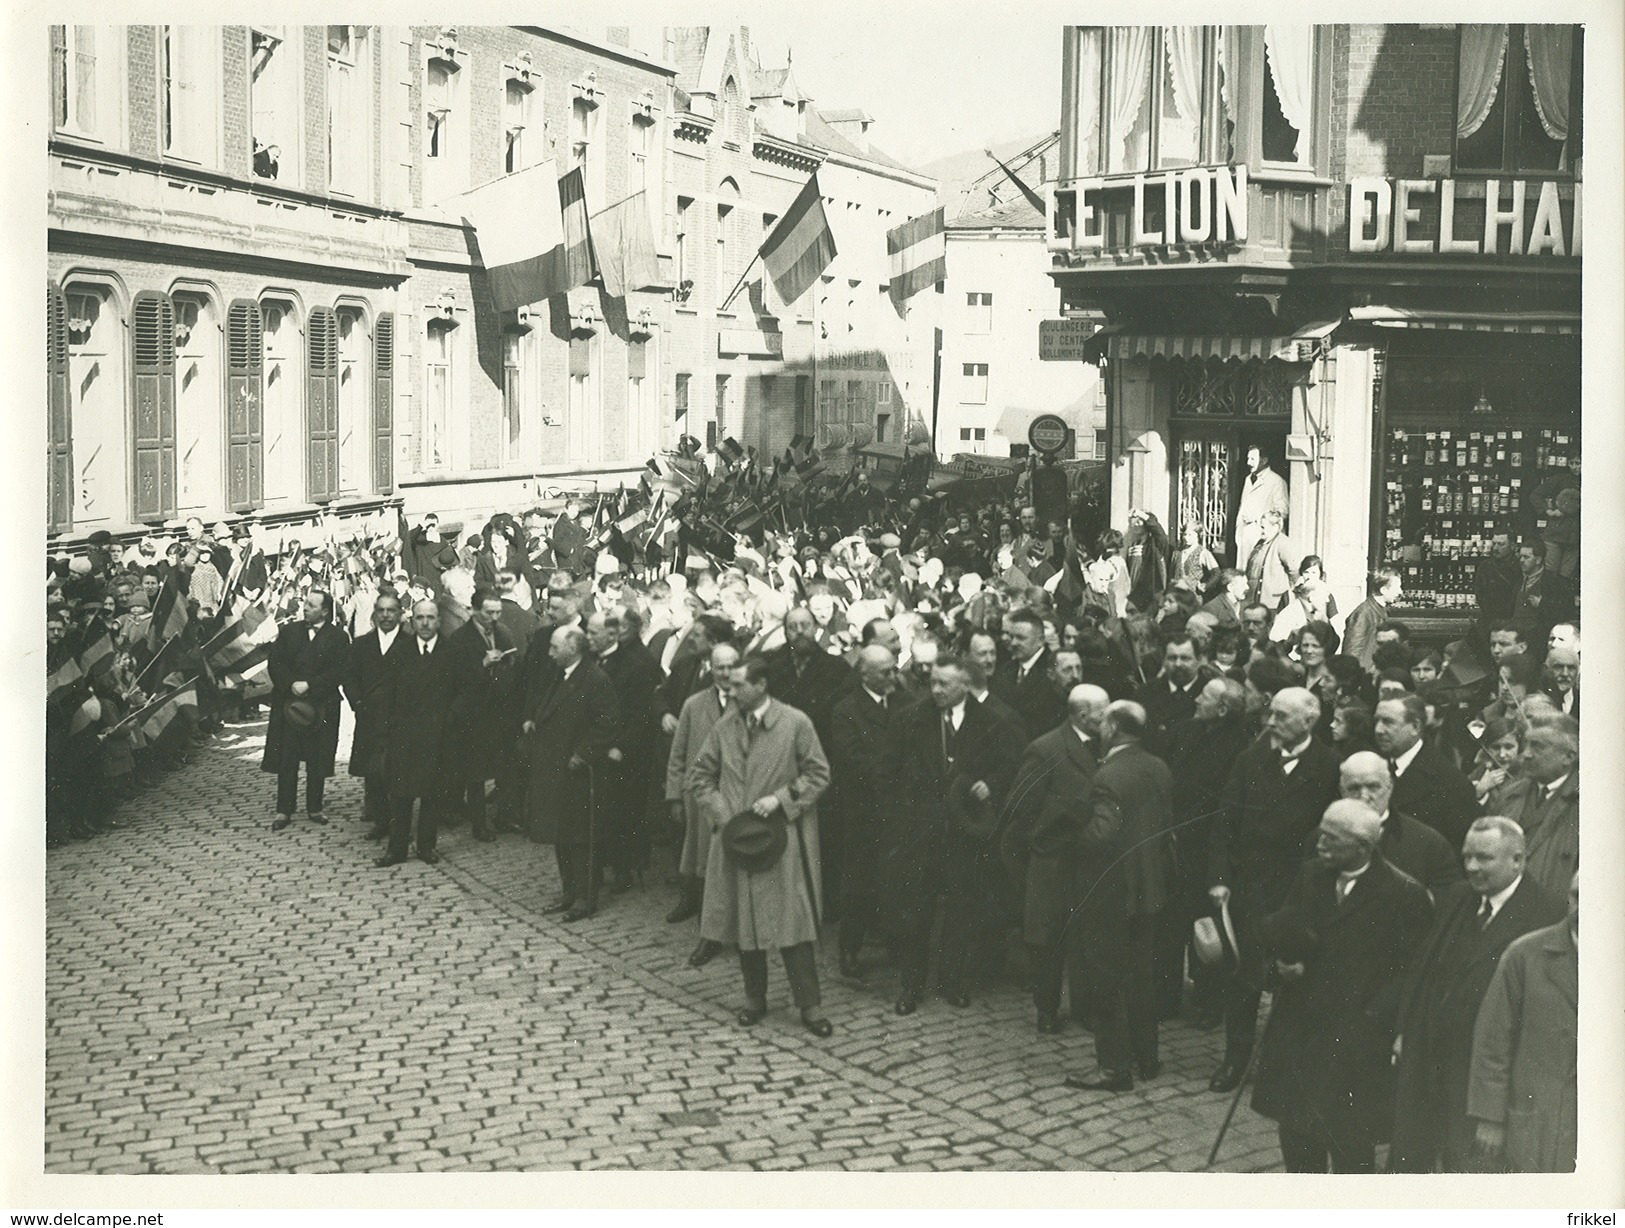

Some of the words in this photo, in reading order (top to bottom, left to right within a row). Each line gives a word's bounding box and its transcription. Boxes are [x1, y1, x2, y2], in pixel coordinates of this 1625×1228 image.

[1045, 178, 1104, 251] LE
[1134, 165, 1248, 246] LION
[1040, 321, 1092, 333] BOULANGERIE
[1043, 334, 1054, 346] DU
[1059, 334, 1089, 346] CENTR
